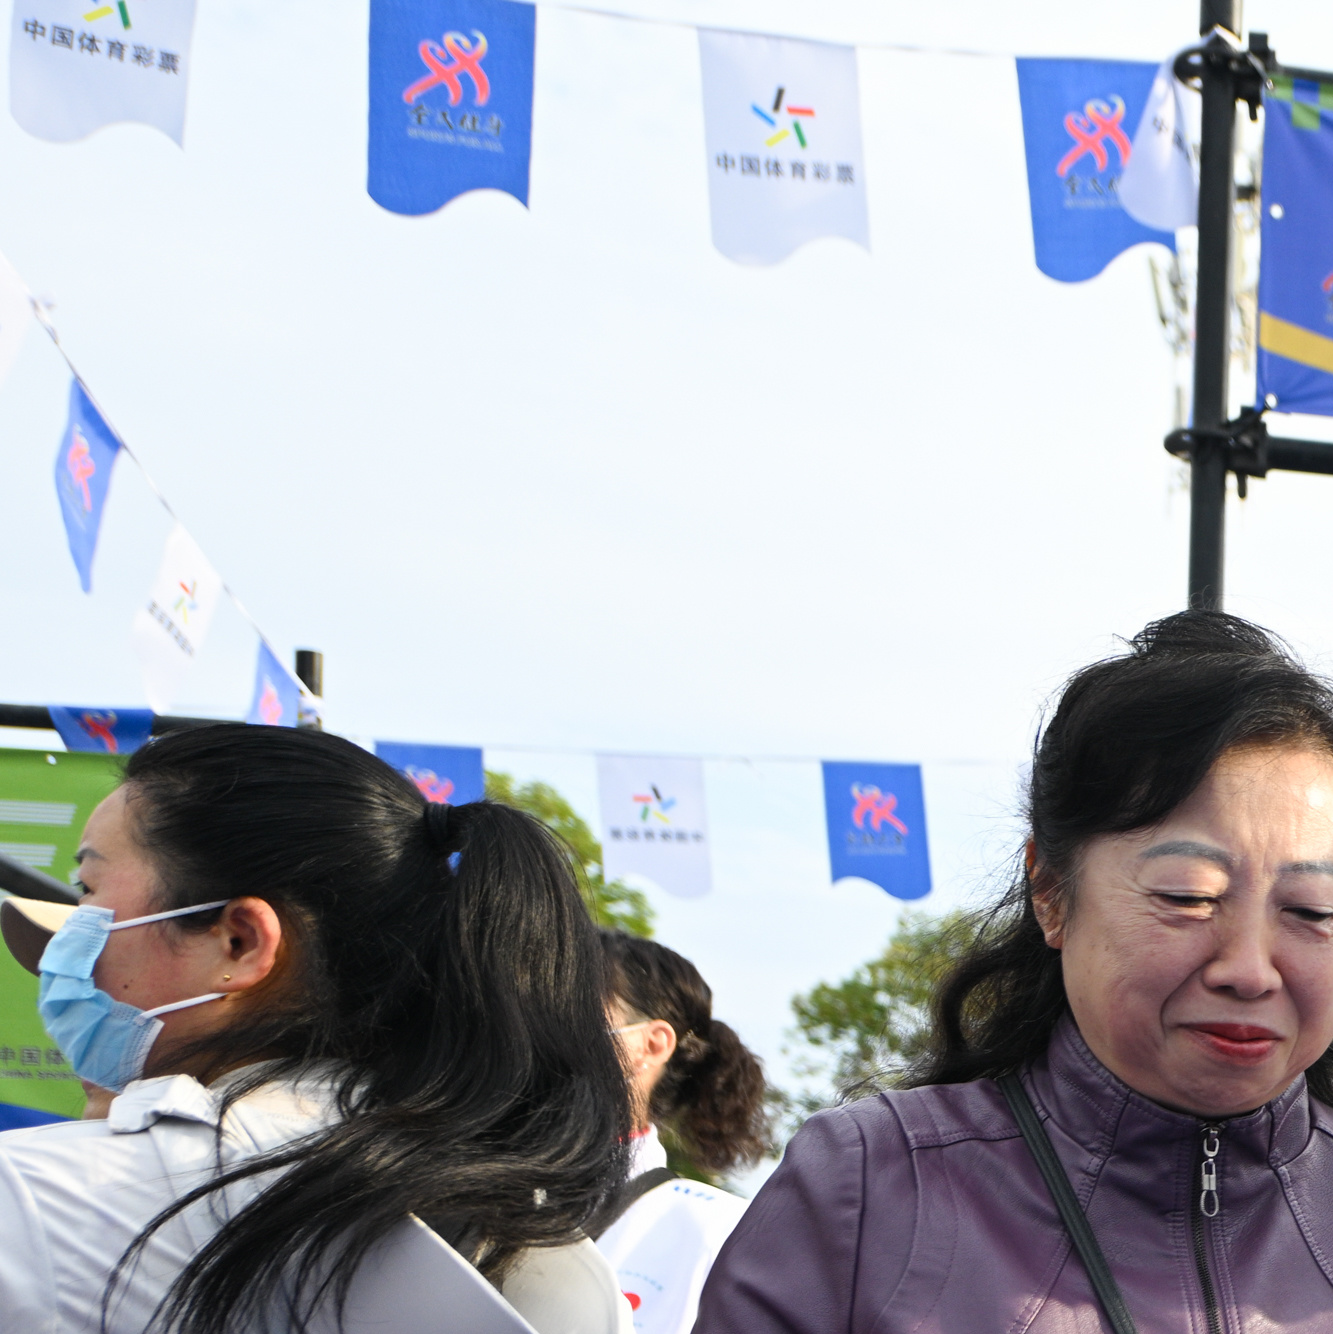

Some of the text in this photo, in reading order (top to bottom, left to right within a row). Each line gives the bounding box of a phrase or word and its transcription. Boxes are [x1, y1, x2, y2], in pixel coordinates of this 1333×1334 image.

[22, 18, 181, 76] 中国体育彩票
[715, 153, 855, 186] 中国体育彩票
